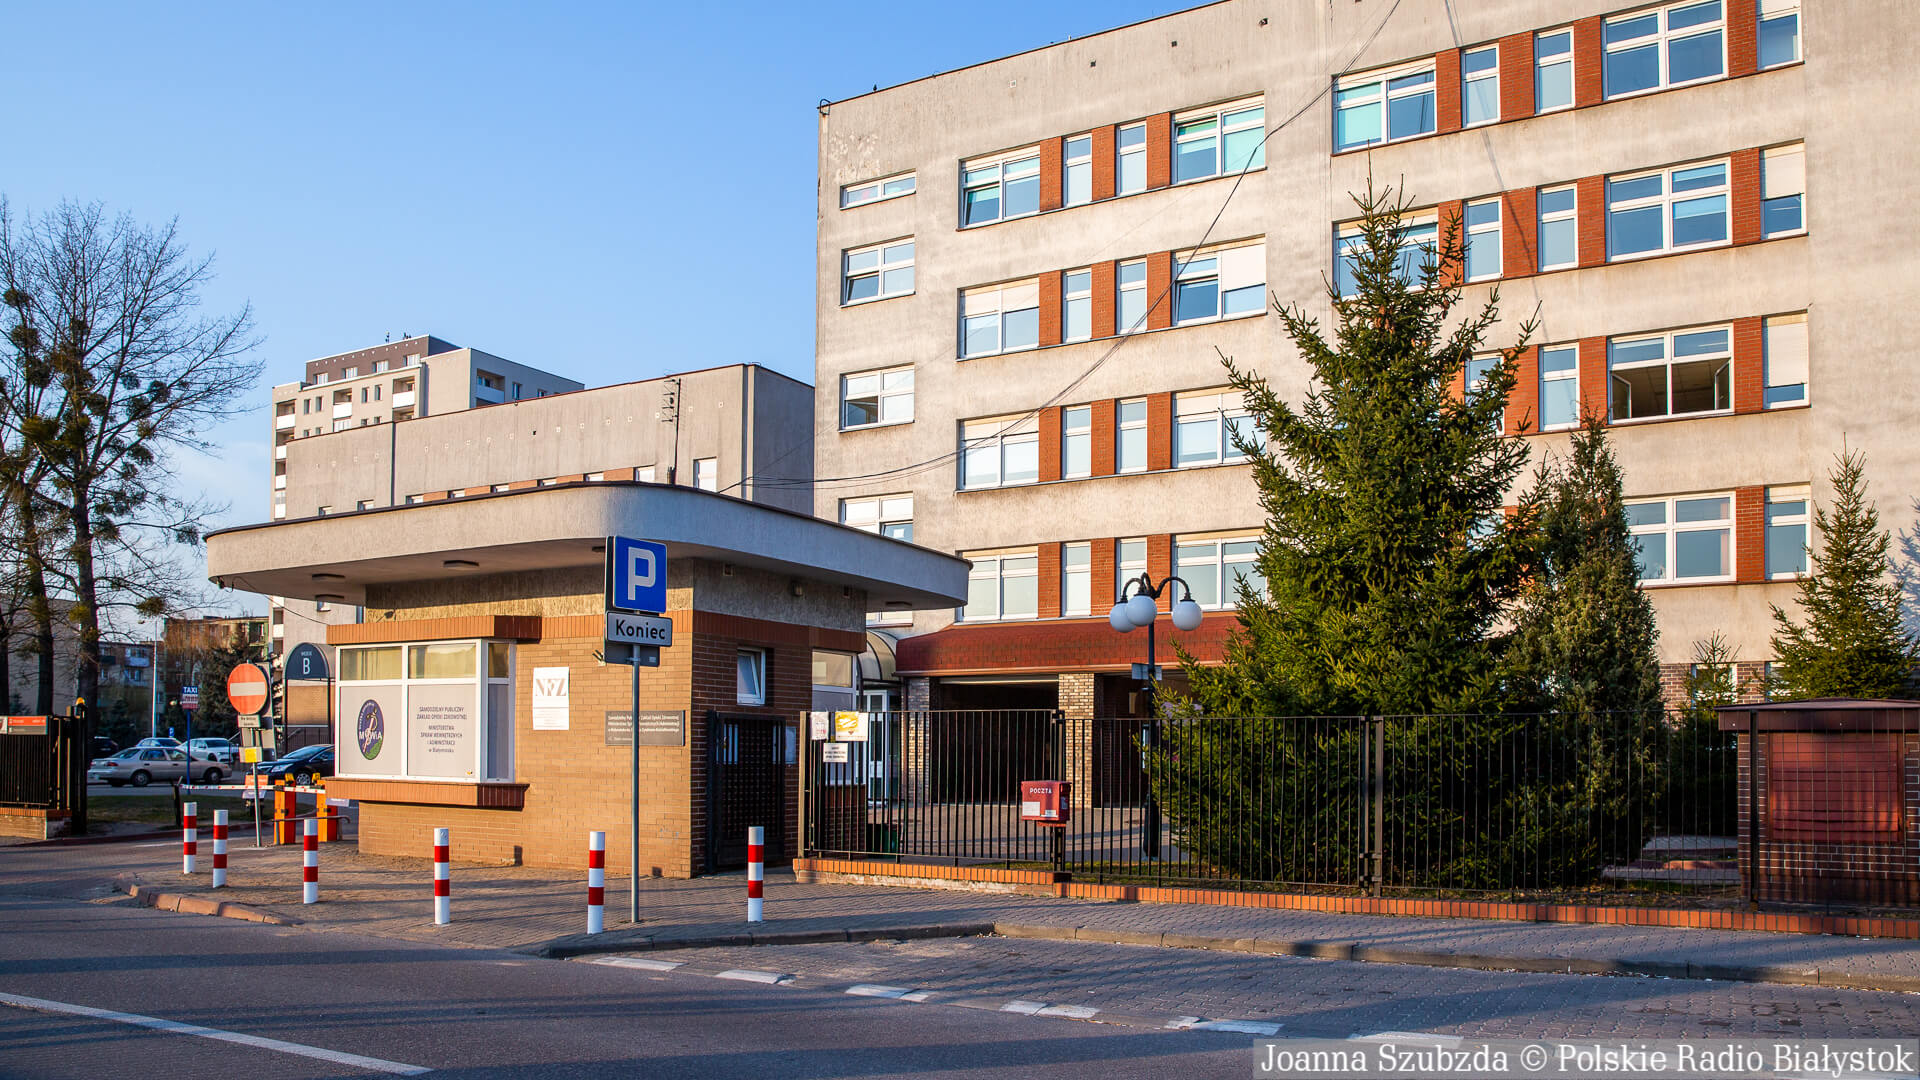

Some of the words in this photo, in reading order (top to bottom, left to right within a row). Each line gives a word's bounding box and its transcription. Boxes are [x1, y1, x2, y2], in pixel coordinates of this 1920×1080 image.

[627, 546, 656, 601] P
[615, 619, 666, 640] Koniec
[303, 657, 311, 675] B
[184, 686, 198, 694] TAXI
[536, 678, 567, 697] NFZ
